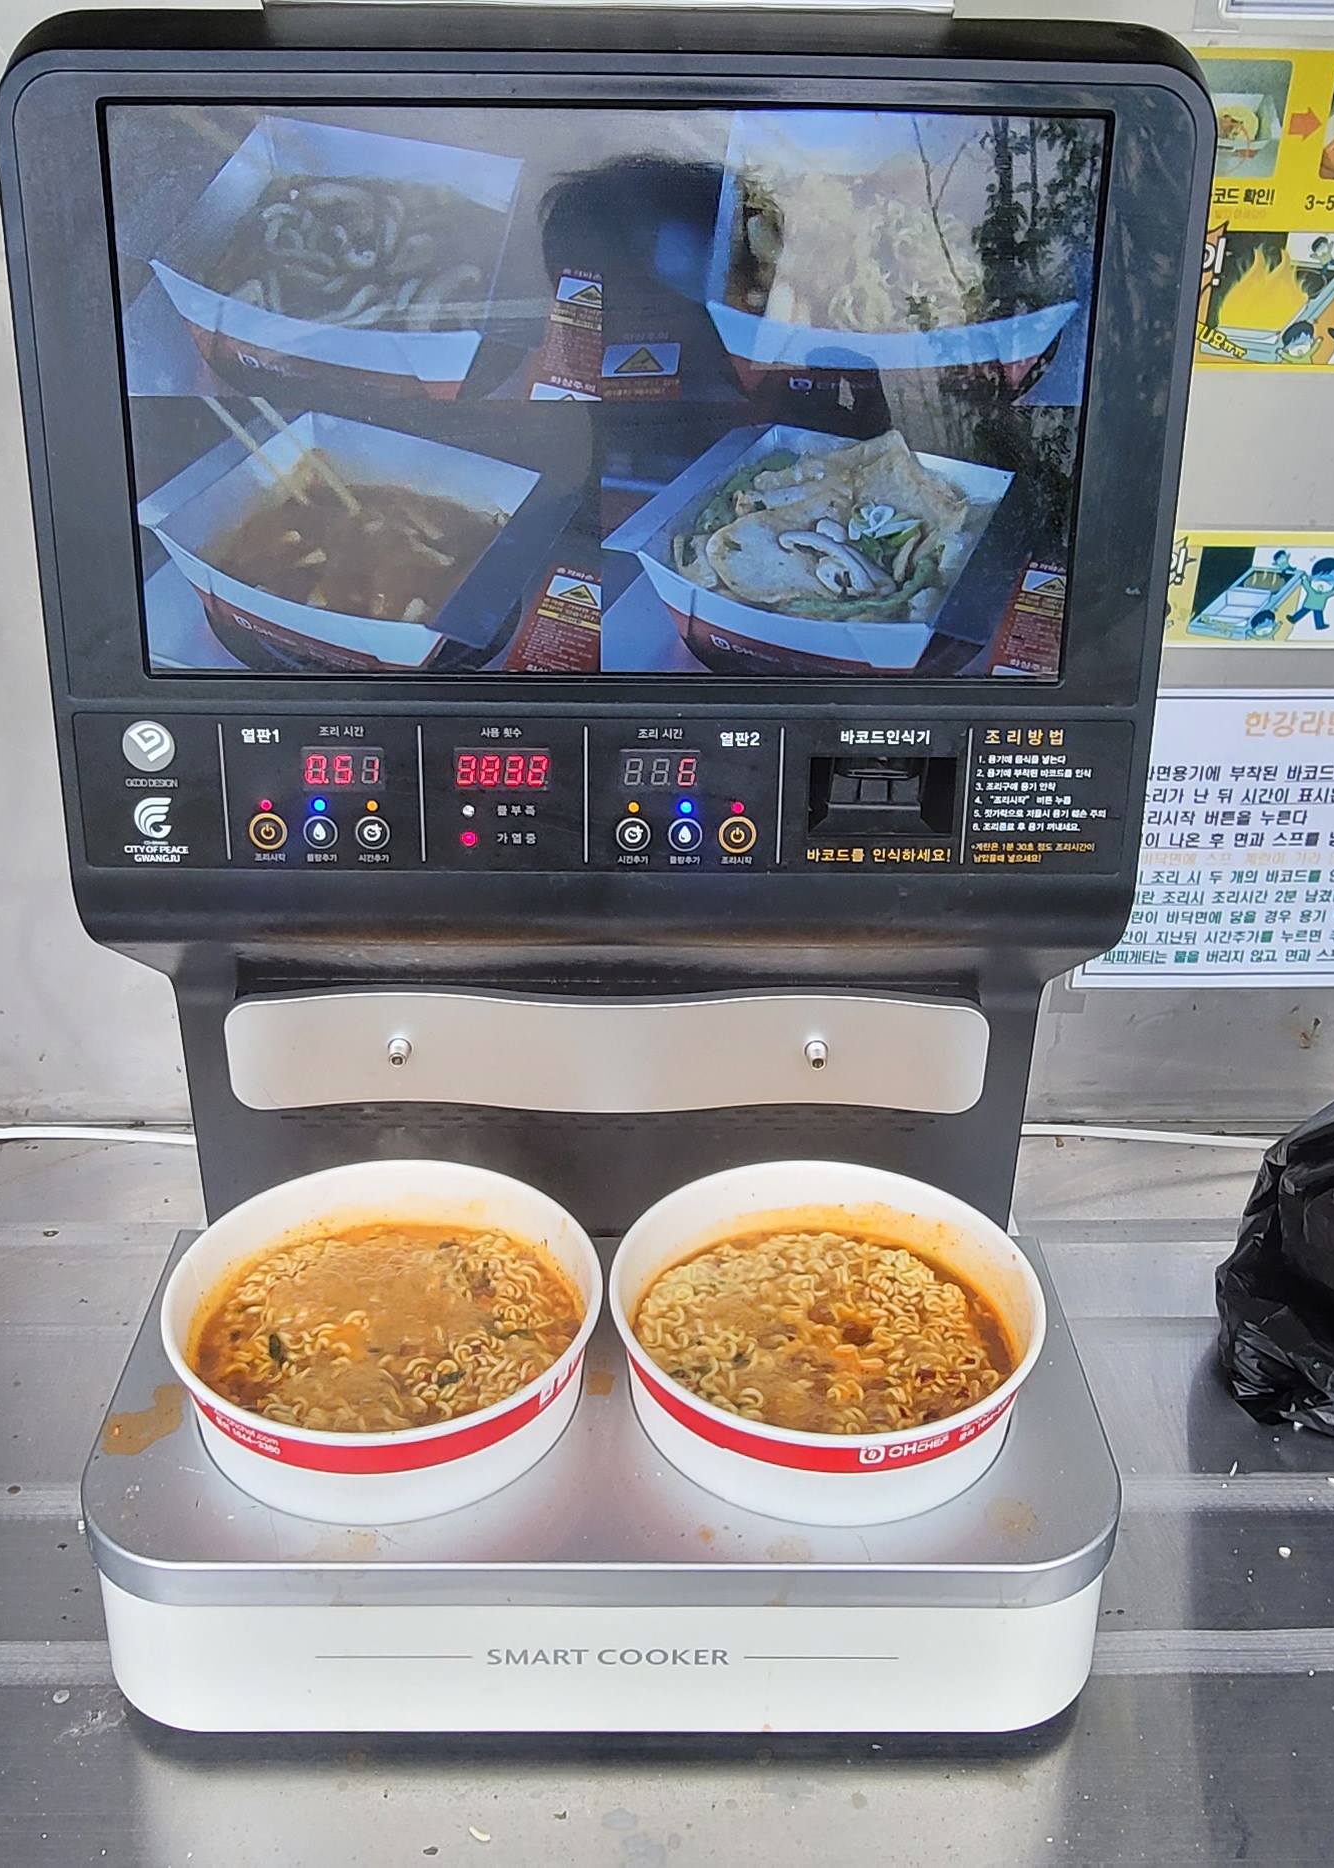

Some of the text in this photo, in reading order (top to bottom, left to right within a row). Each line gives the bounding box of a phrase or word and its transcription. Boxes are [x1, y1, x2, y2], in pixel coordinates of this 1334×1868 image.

[1244, 189, 1276, 207] 확인!
[241, 728, 280, 744] 열판1
[319, 726, 365, 738] 조리 시간
[480, 727, 500, 738] 사용
[637, 728, 683, 740] 조리 시간
[720, 731, 761, 747] 열판2
[840, 729, 931, 745] 바코드인식기
[1229, 765, 1279, 782] 부착된
[1144, 788, 1185, 804] 리가
[1193, 788, 1209, 804] 난
[1217, 788, 1234, 804] 뒤
[1242, 788, 1290, 804] 시간이
[1142, 809, 1308, 827] 리시작 버튼을 누른다
[1169, 832, 1201, 848] 나온
[1209, 832, 1225, 848] 후
[1234, 832, 1265, 847] 면과
[1272, 832, 1320, 847] 스프를
[124, 845, 190, 855] CITY OF PEACE
[806, 847, 952, 863] 바코드를 인식하세요!
[134, 854, 181, 863] GWANGJU
[486, 1648, 730, 1666] SMART COOKER
